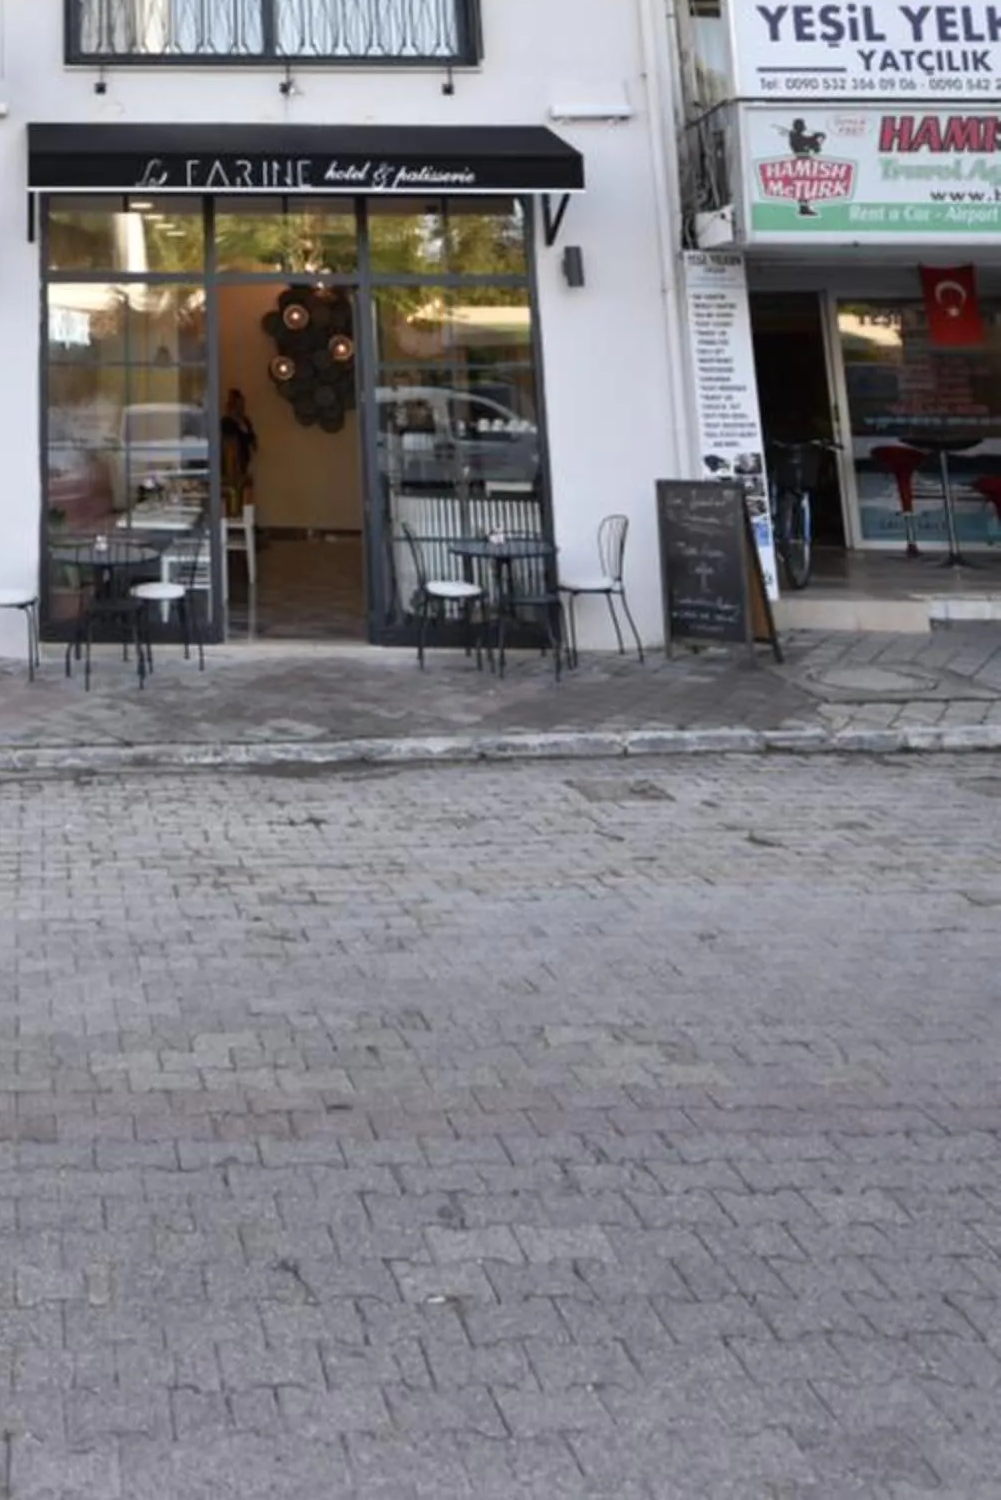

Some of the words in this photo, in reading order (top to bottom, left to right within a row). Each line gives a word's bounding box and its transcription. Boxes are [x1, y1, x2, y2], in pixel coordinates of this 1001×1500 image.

[857, 49, 993, 76] YATÇILIK
[785, 77, 819, 91] 0090
[900, 77, 917, 91] 06
[929, 77, 963, 91] 0090
[878, 115, 1001, 153] HAMI
[185, 159, 311, 188] FARINE
[324, 160, 371, 181] hotel
[766, 161, 847, 180] HAMISH
[766, 179, 848, 199] McTURK
[849, 205, 886, 221] Rent
[903, 206, 931, 221] Car
